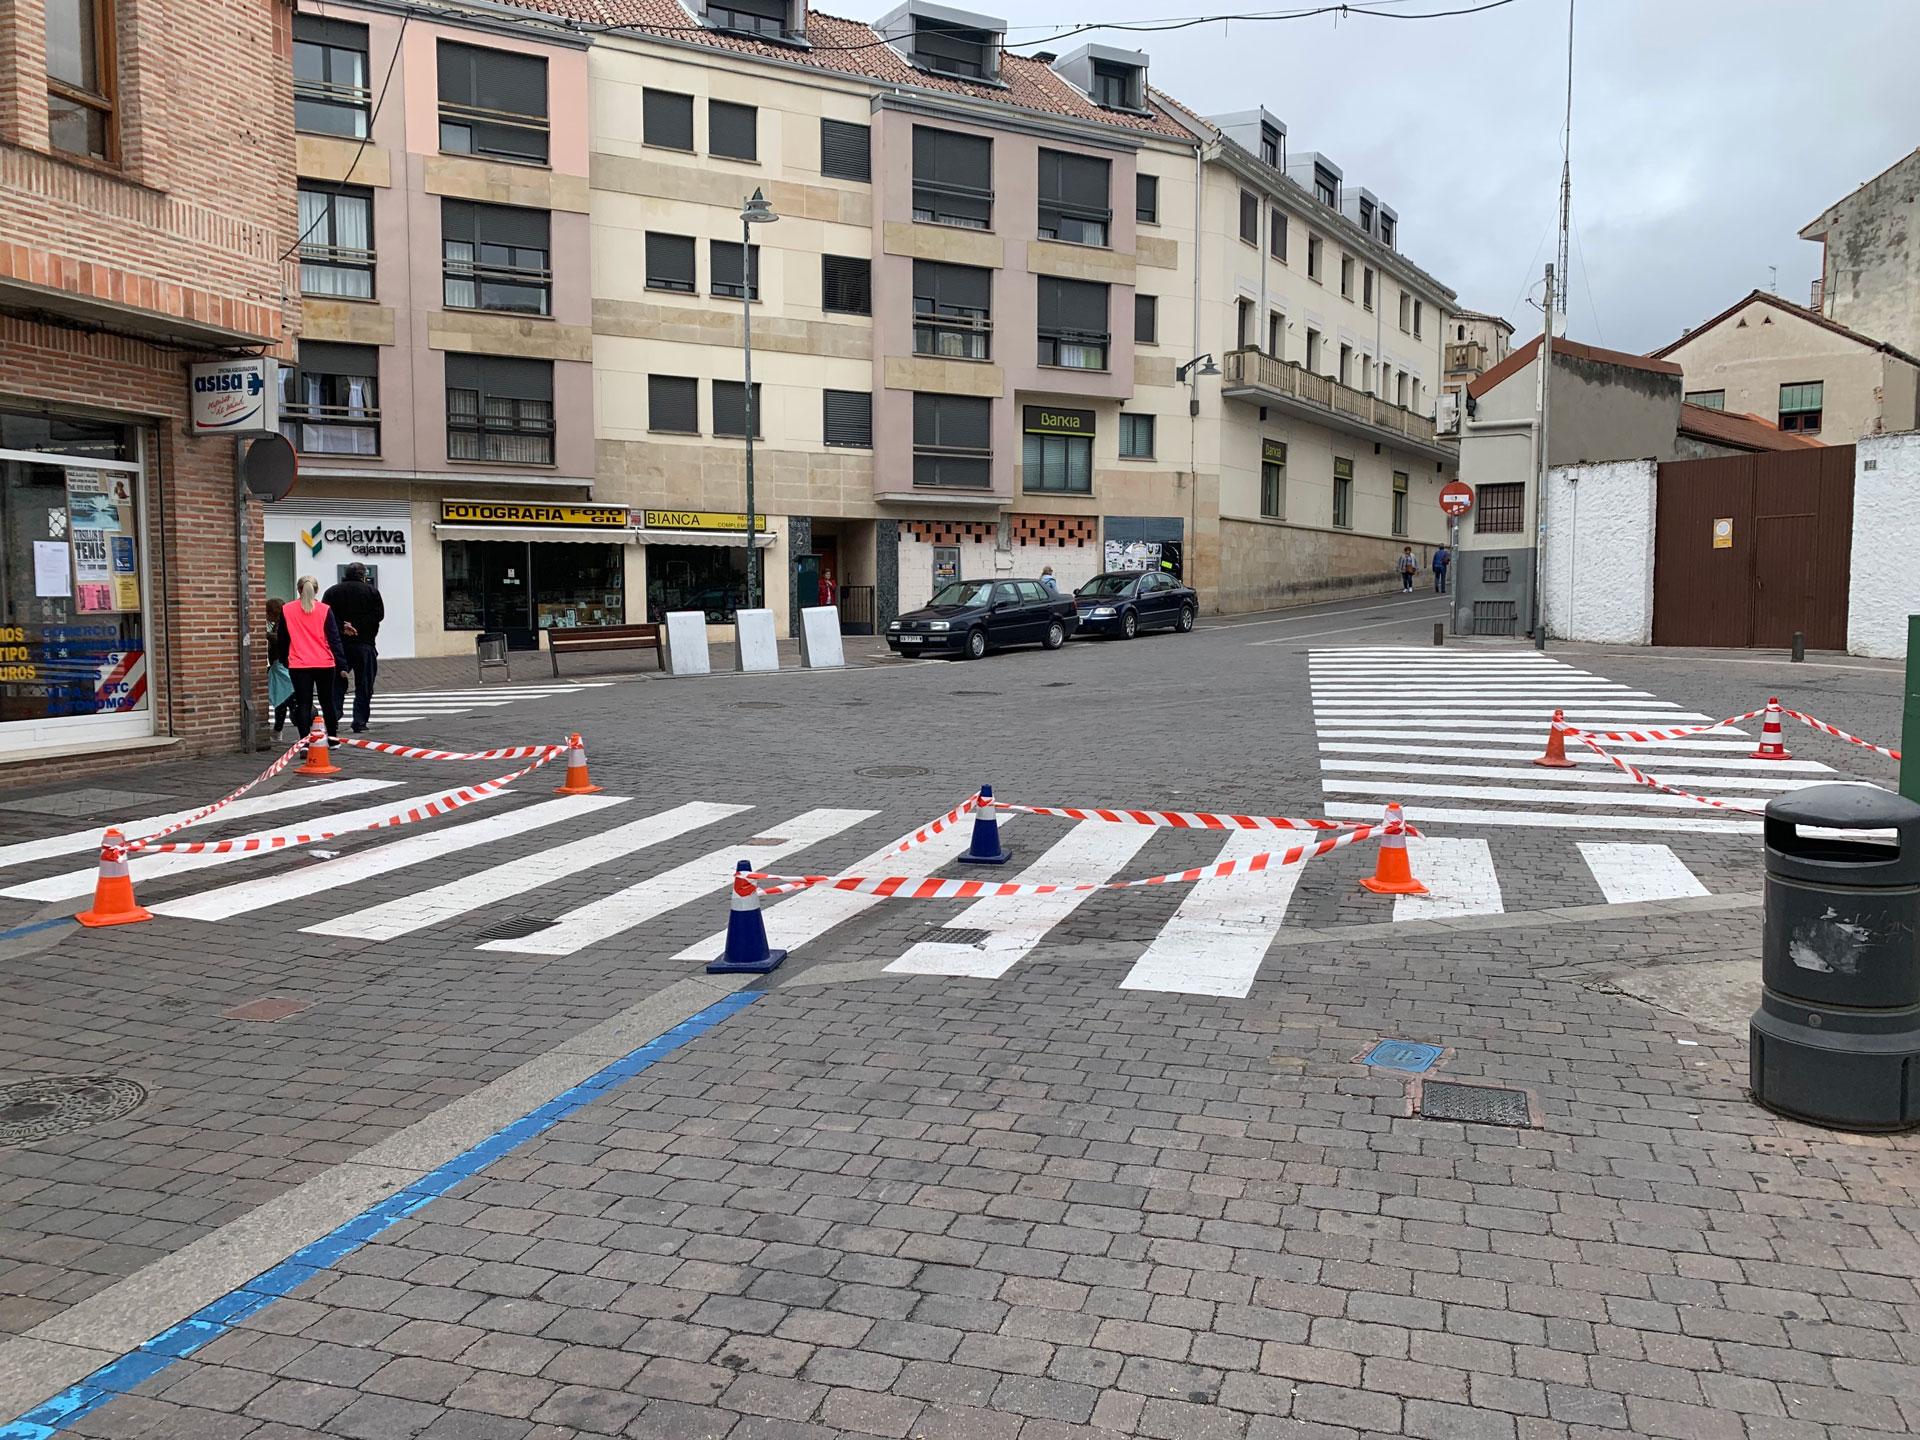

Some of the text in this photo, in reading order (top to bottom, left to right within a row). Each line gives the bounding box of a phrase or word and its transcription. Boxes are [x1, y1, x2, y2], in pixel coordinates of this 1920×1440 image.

[195, 374, 242, 392] asisa
[1041, 412, 1080, 428] Bankia
[1265, 444, 1281, 458] Bankia
[445, 505, 563, 521] FOTOGRAFIA
[647, 512, 701, 526] BIANCA
[324, 525, 405, 546] cajaviva
[75, 542, 106, 560] TENIS
[351, 542, 406, 556] cajarural
[42, 625, 118, 638] COMERCIO
[47, 696, 136, 714] AUTONOMOS
